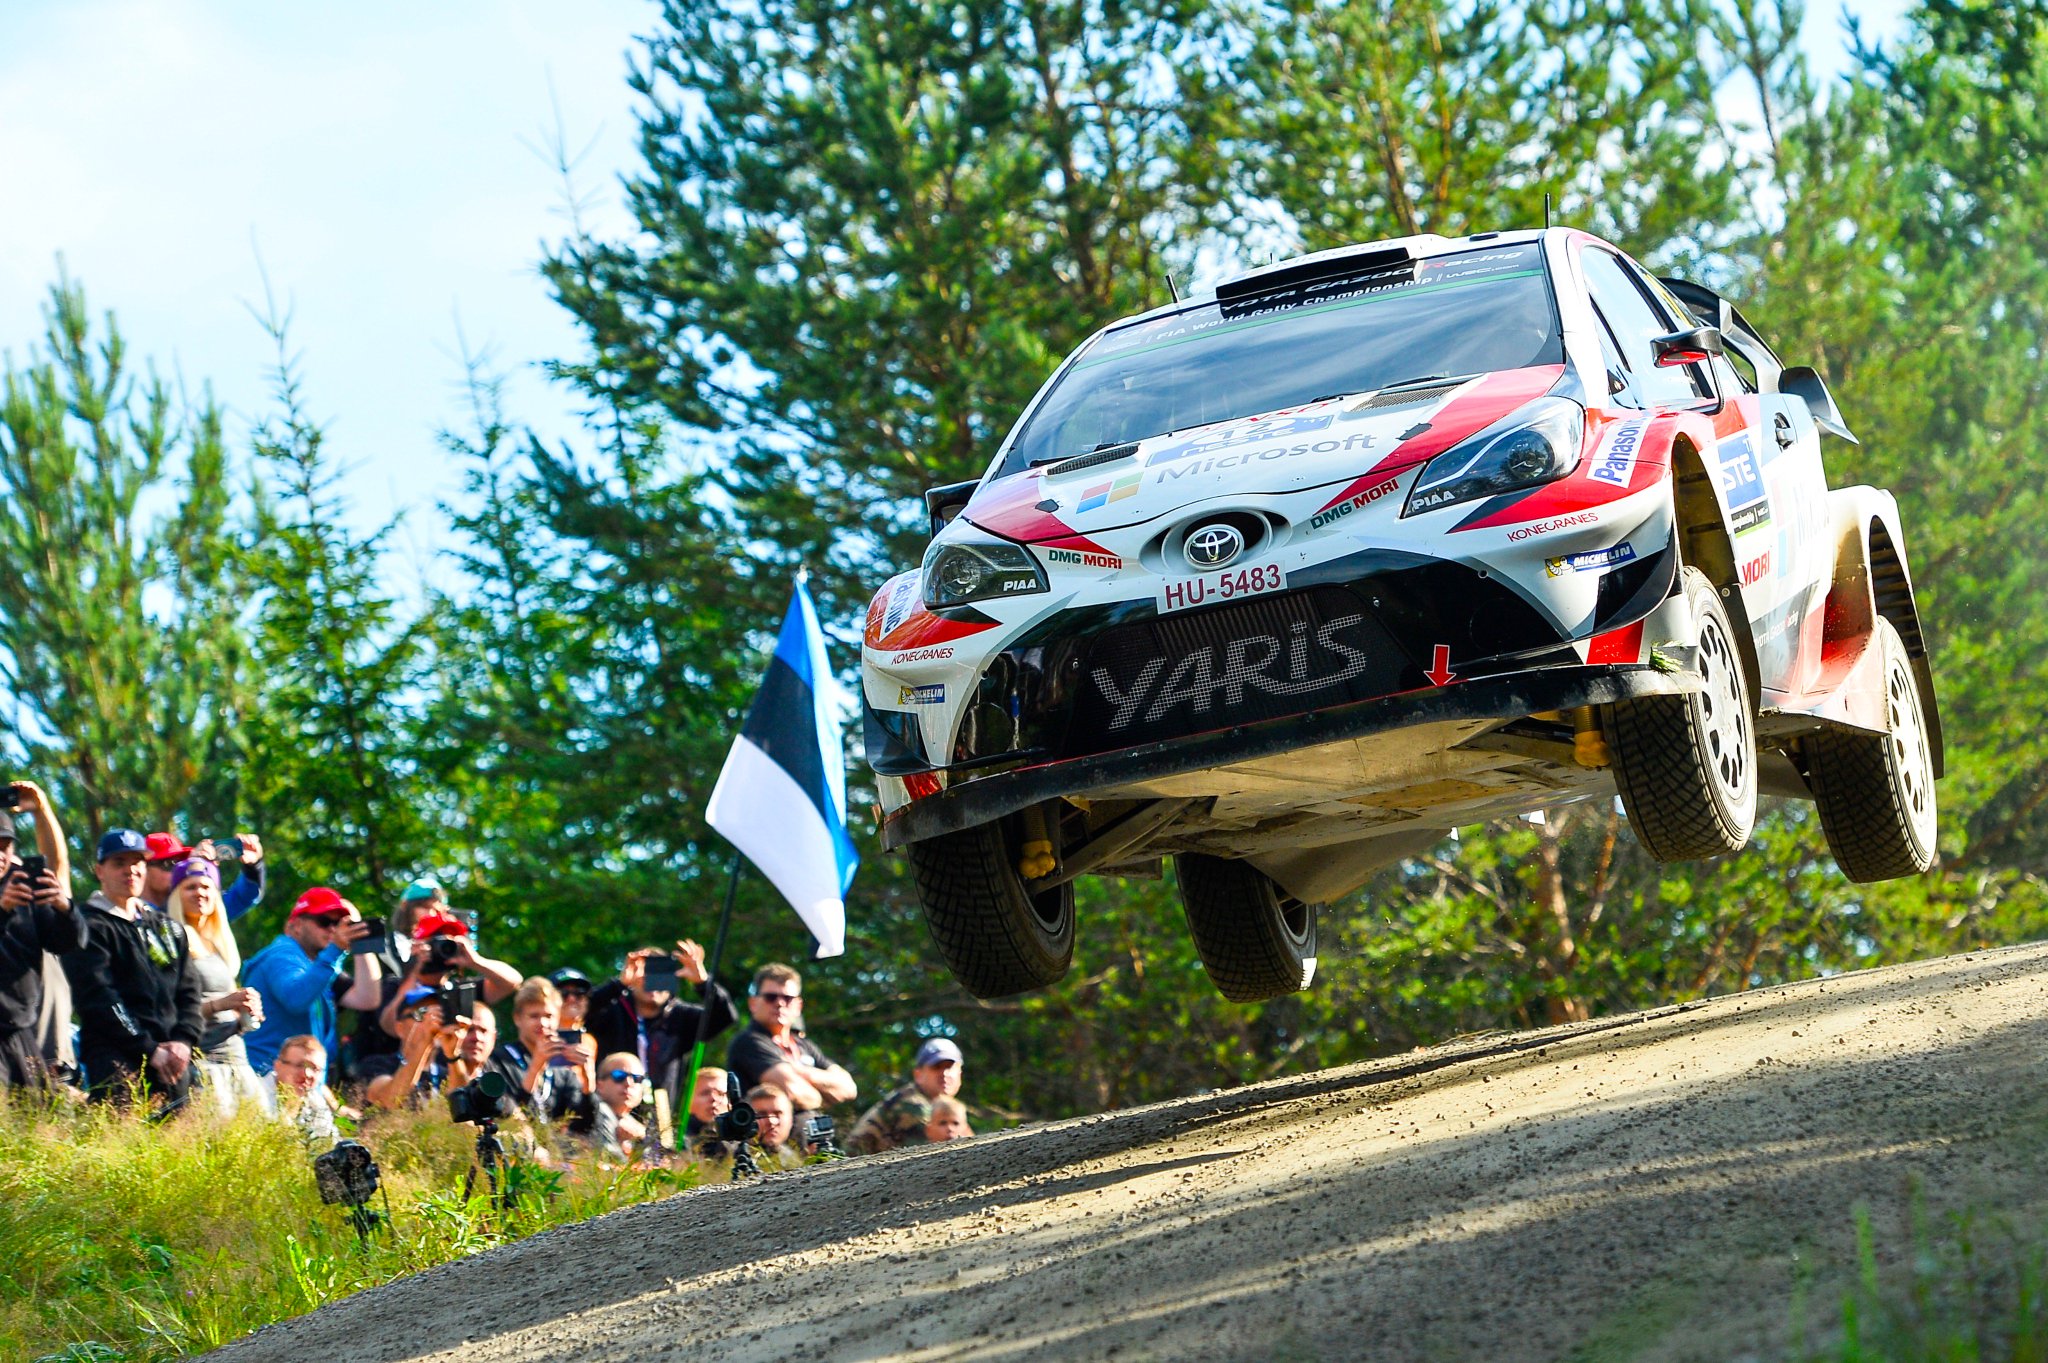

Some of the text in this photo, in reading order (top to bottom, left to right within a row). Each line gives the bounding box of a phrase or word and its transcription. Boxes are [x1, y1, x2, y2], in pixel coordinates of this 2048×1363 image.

[1304, 266, 1414, 293] GAZOO
[1423, 250, 1524, 270] Racing
[1156, 328, 1186, 341] FIA
[1192, 312, 1247, 331] World
[1249, 302, 1297, 317] Rally
[1302, 276, 1433, 306] Championship
[1216, 421, 1271, 440] 12
[1157, 433, 1378, 484] Microsoft
[1310, 478, 1399, 530] DMG MORI
[1411, 490, 1456, 511] PIAA
[1507, 512, 1599, 543] KONECRANES
[1048, 549, 1123, 570] DMG MORI
[1573, 545, 1631, 567] MICHELIN
[1003, 578, 1037, 592] PIAA
[1165, 564, 1281, 610] HU-5483
[891, 647, 954, 666] KONECRANES
